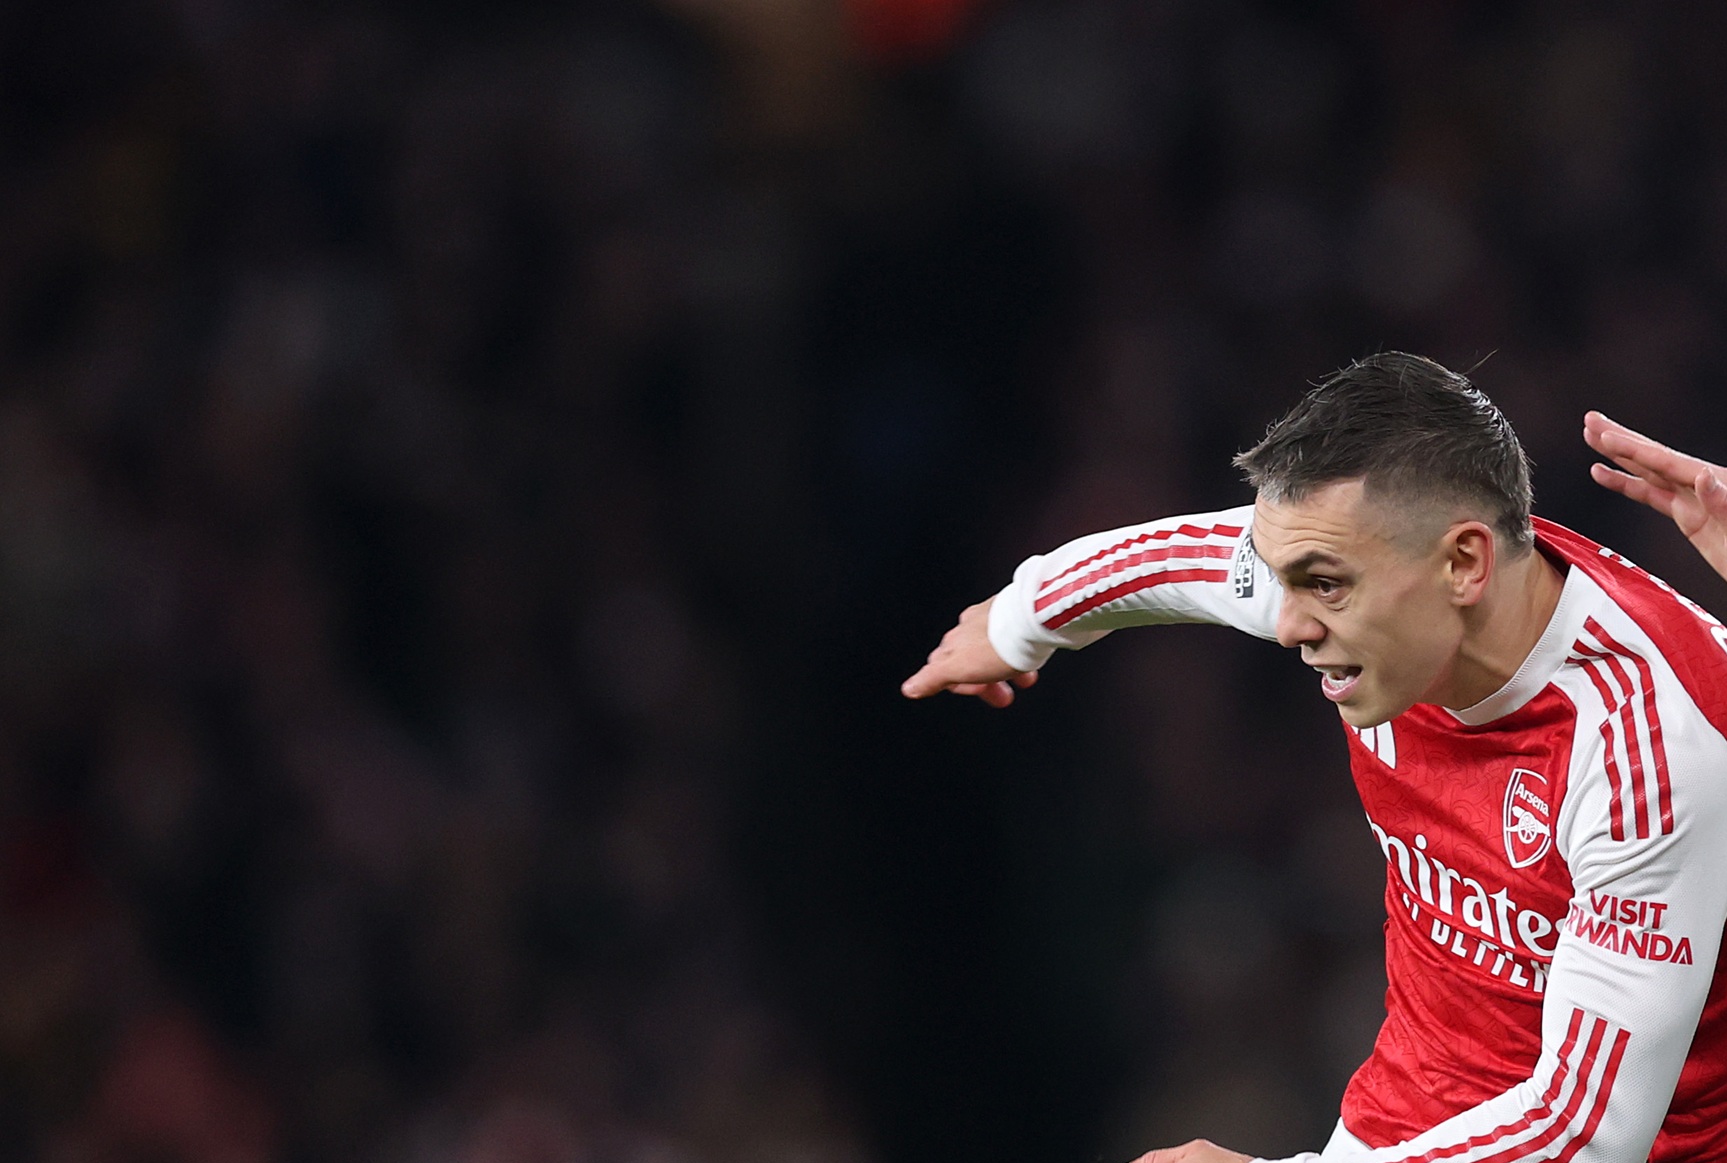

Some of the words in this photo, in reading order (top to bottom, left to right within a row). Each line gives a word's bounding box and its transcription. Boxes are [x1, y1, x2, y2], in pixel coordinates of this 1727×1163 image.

[1515, 783, 1550, 818] Arsena
[1366, 811, 1566, 957] mirate
[1589, 888, 1668, 930] VISIT
[1565, 903, 1693, 965] RWANDA
